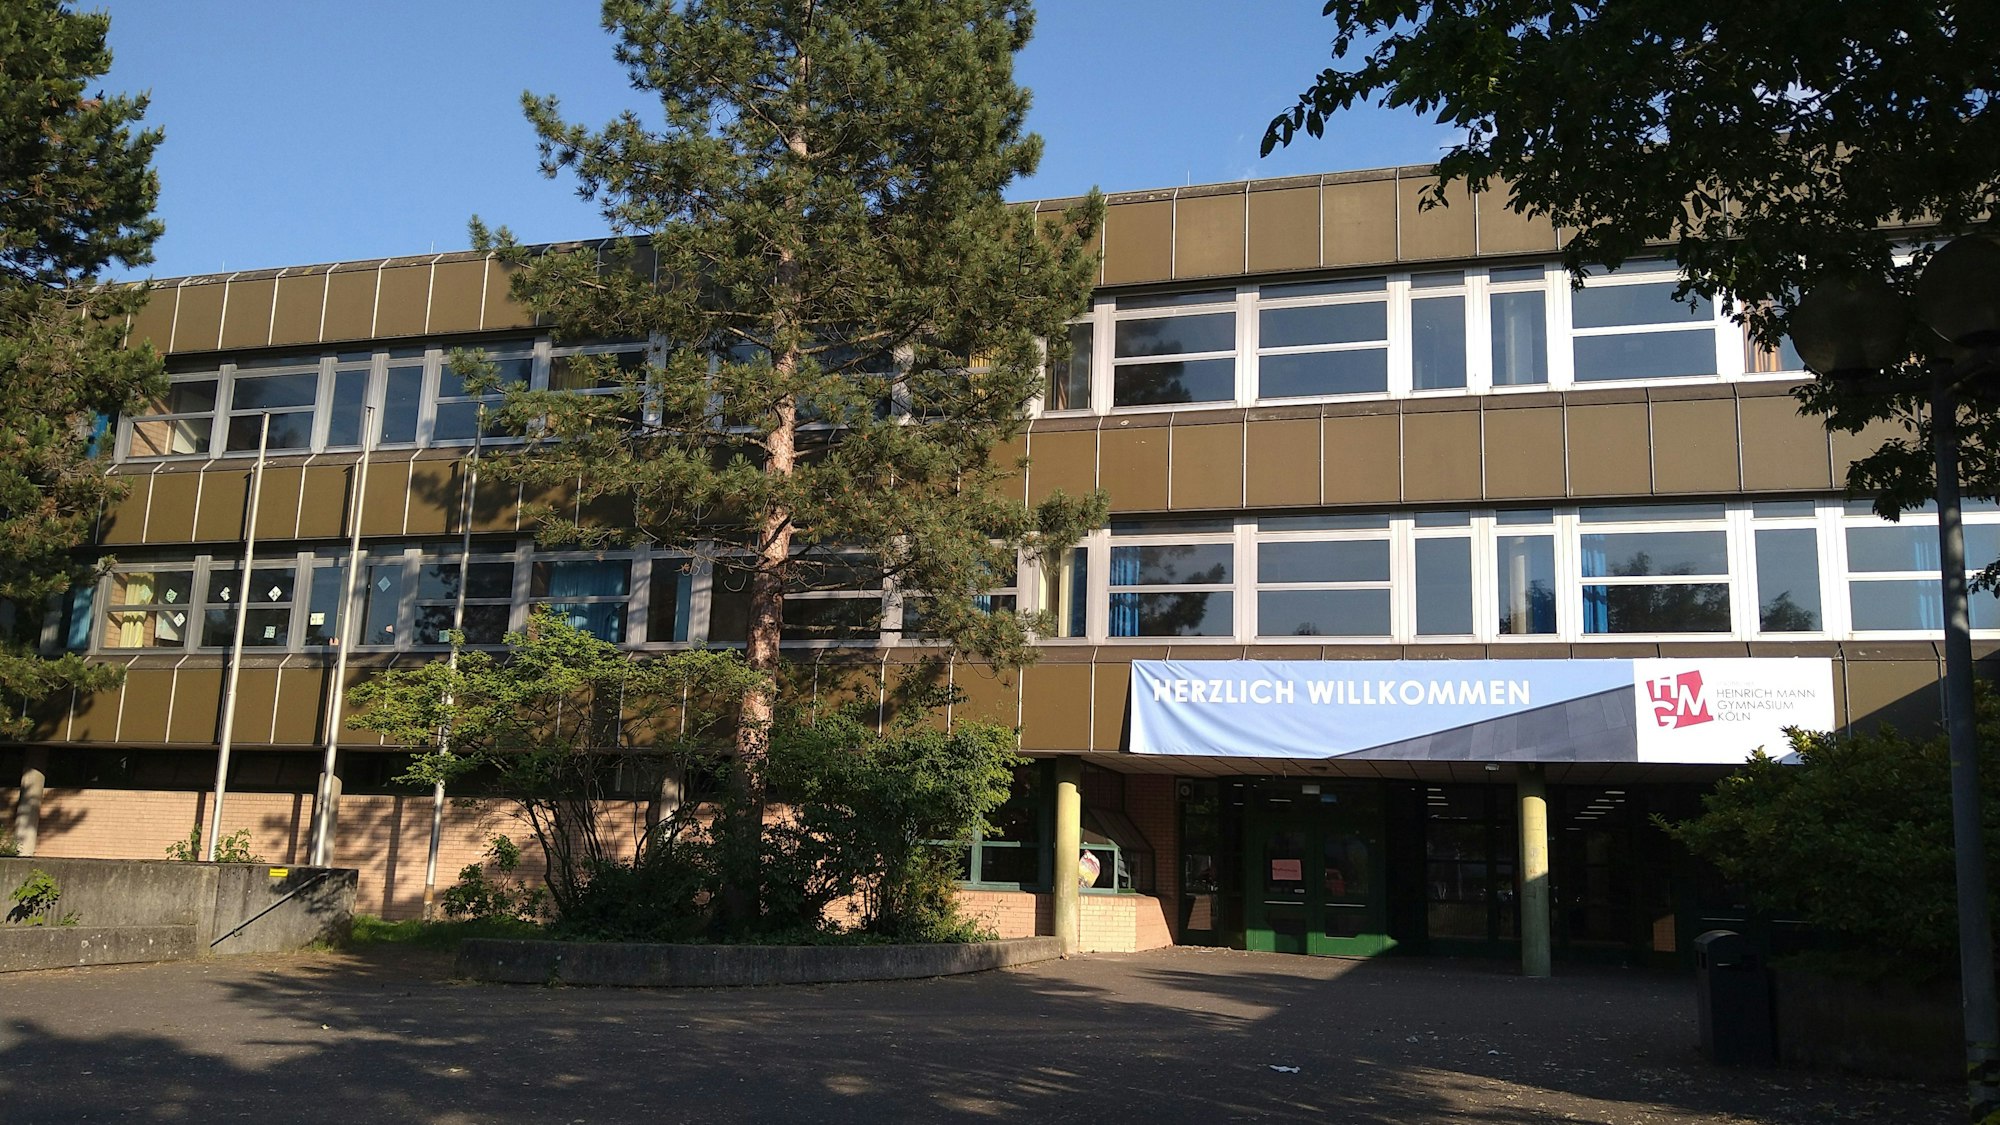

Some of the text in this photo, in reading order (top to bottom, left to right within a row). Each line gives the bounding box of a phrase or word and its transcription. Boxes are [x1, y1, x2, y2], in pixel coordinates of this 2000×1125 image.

[1153, 679, 1531, 706] HERZLICH WILLKOMMEN
[1716, 688, 1816, 699] HEINRICH MANN
[1717, 699, 1794, 710] GYMNASIUM
[1717, 709, 1751, 721] KÖLN
